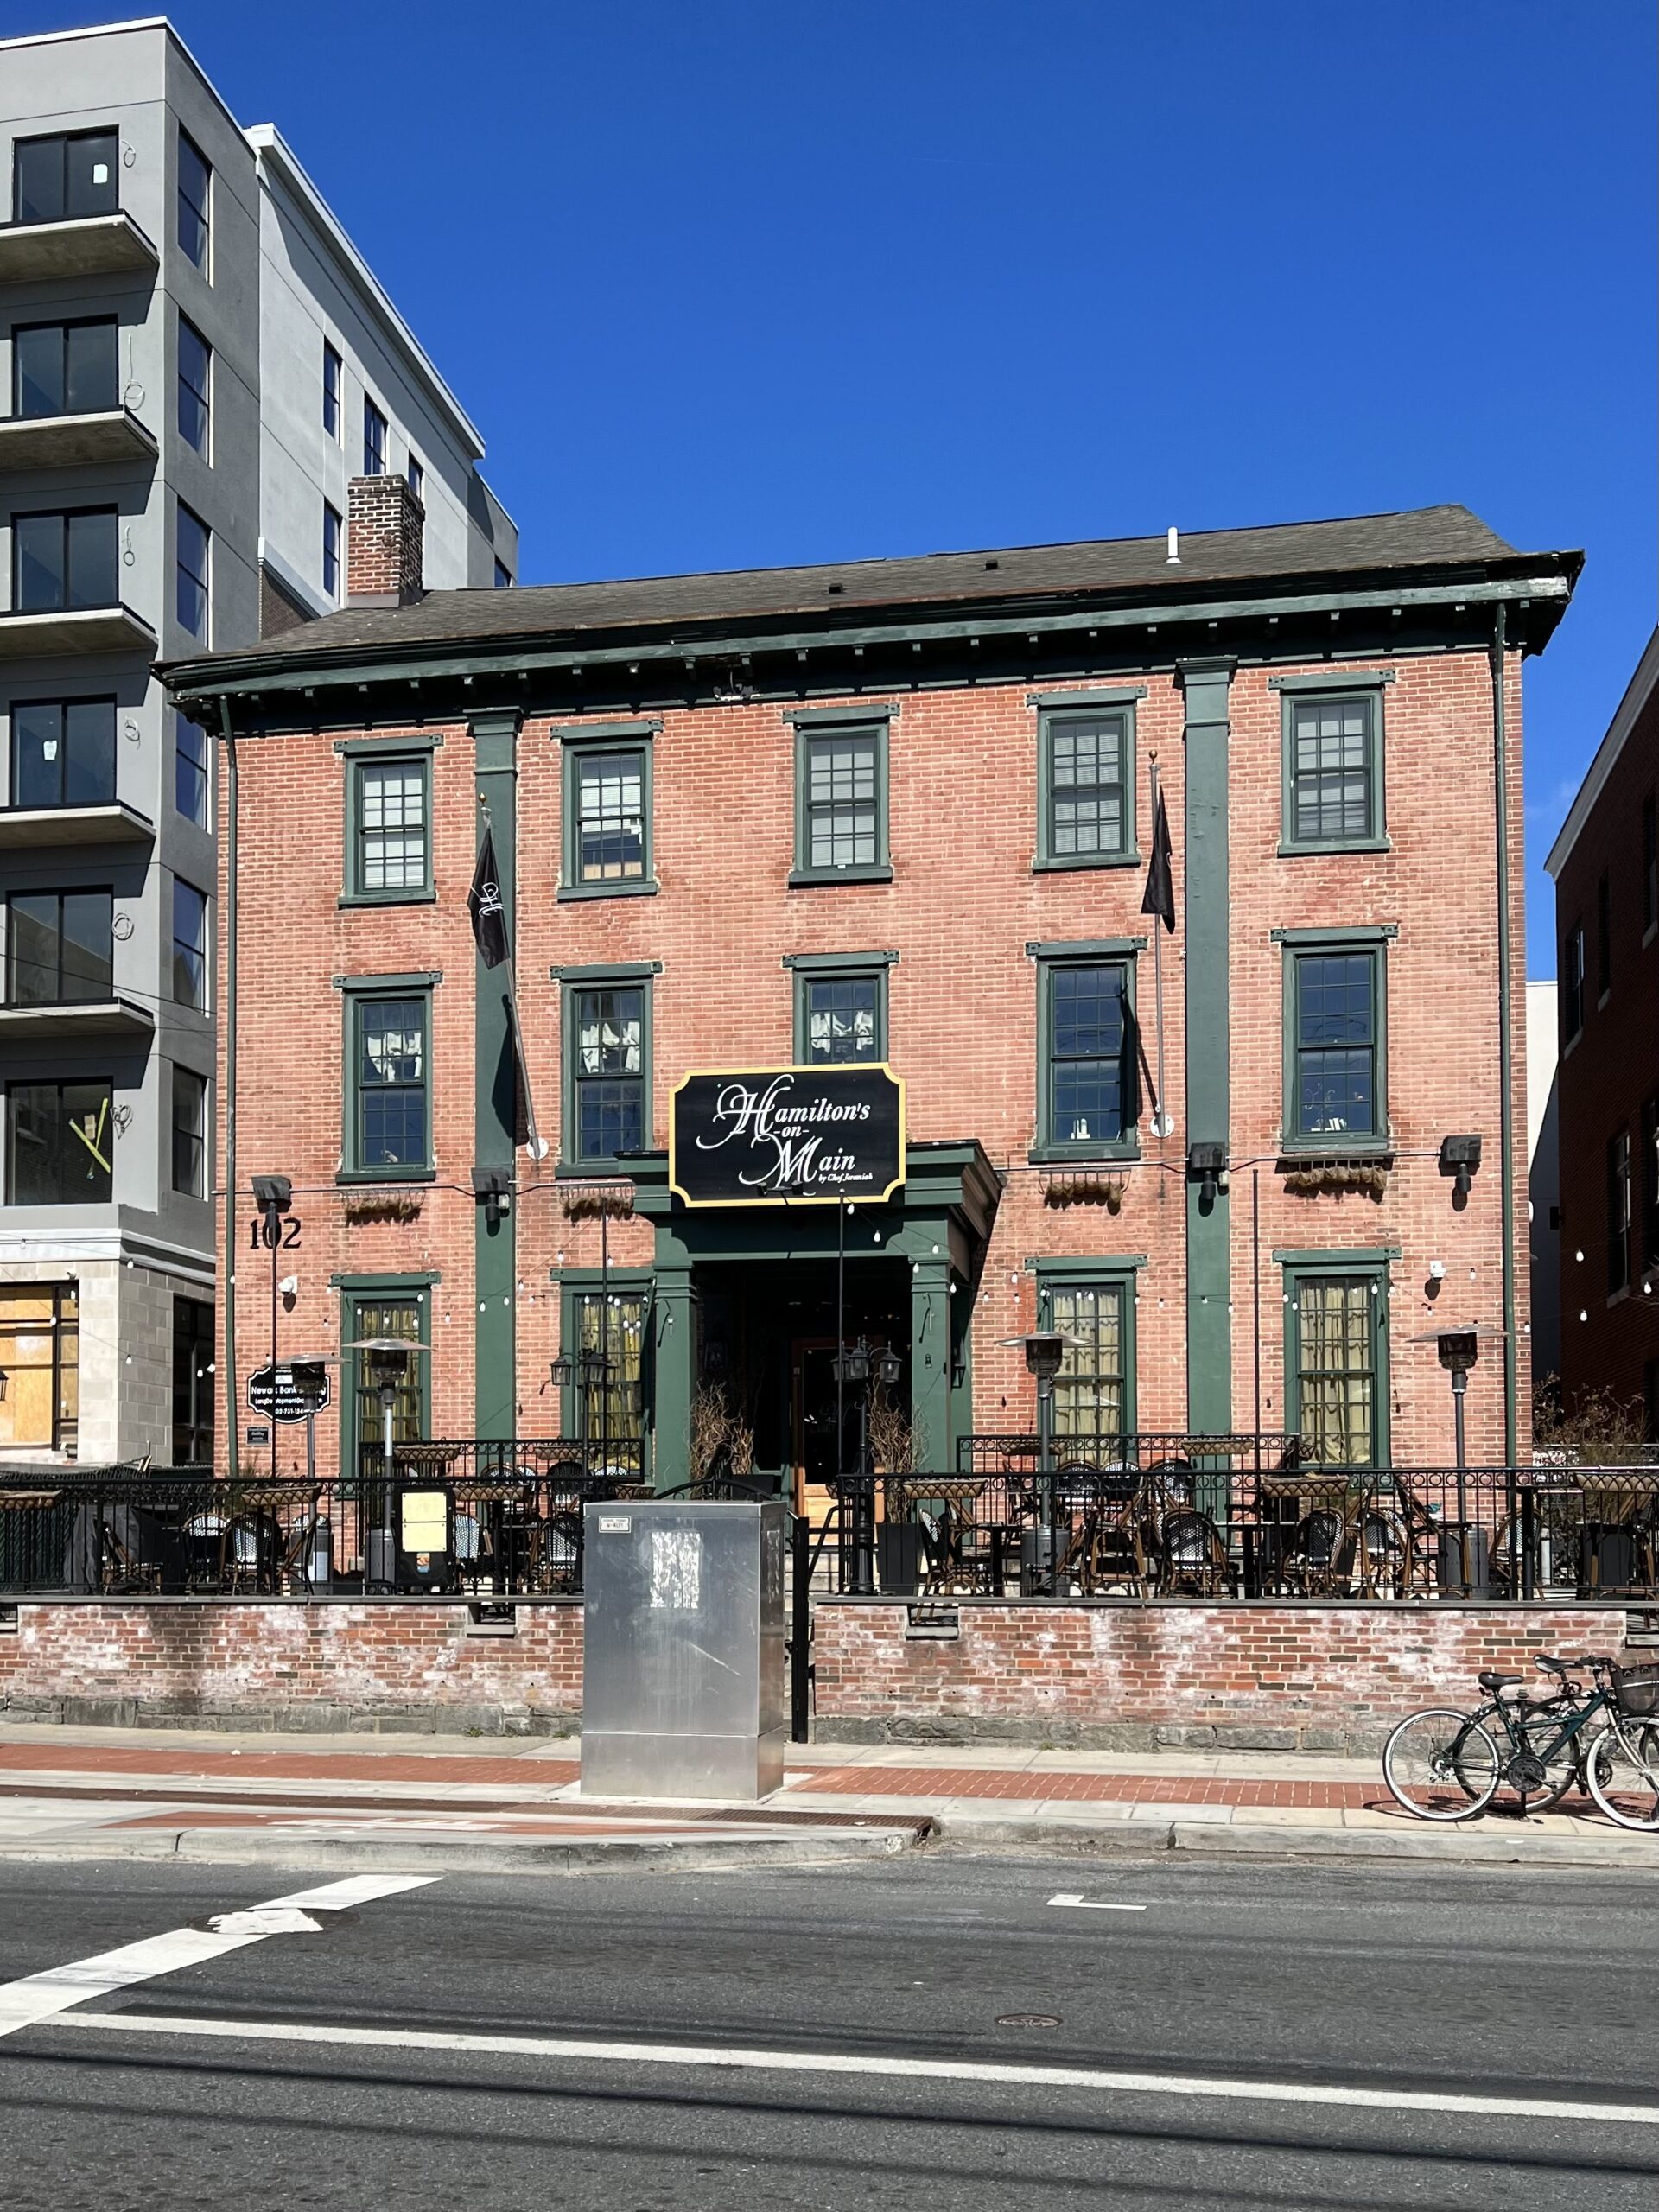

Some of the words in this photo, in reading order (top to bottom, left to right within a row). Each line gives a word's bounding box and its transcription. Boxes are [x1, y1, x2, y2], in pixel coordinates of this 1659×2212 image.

[696, 1074, 871, 1149] Hamilton's
[738, 1133, 855, 1188] Main
[818, 1173, 828, 1184] by
[827, 1173, 844, 1184] Chef
[250, 1217, 302, 1249] 102
